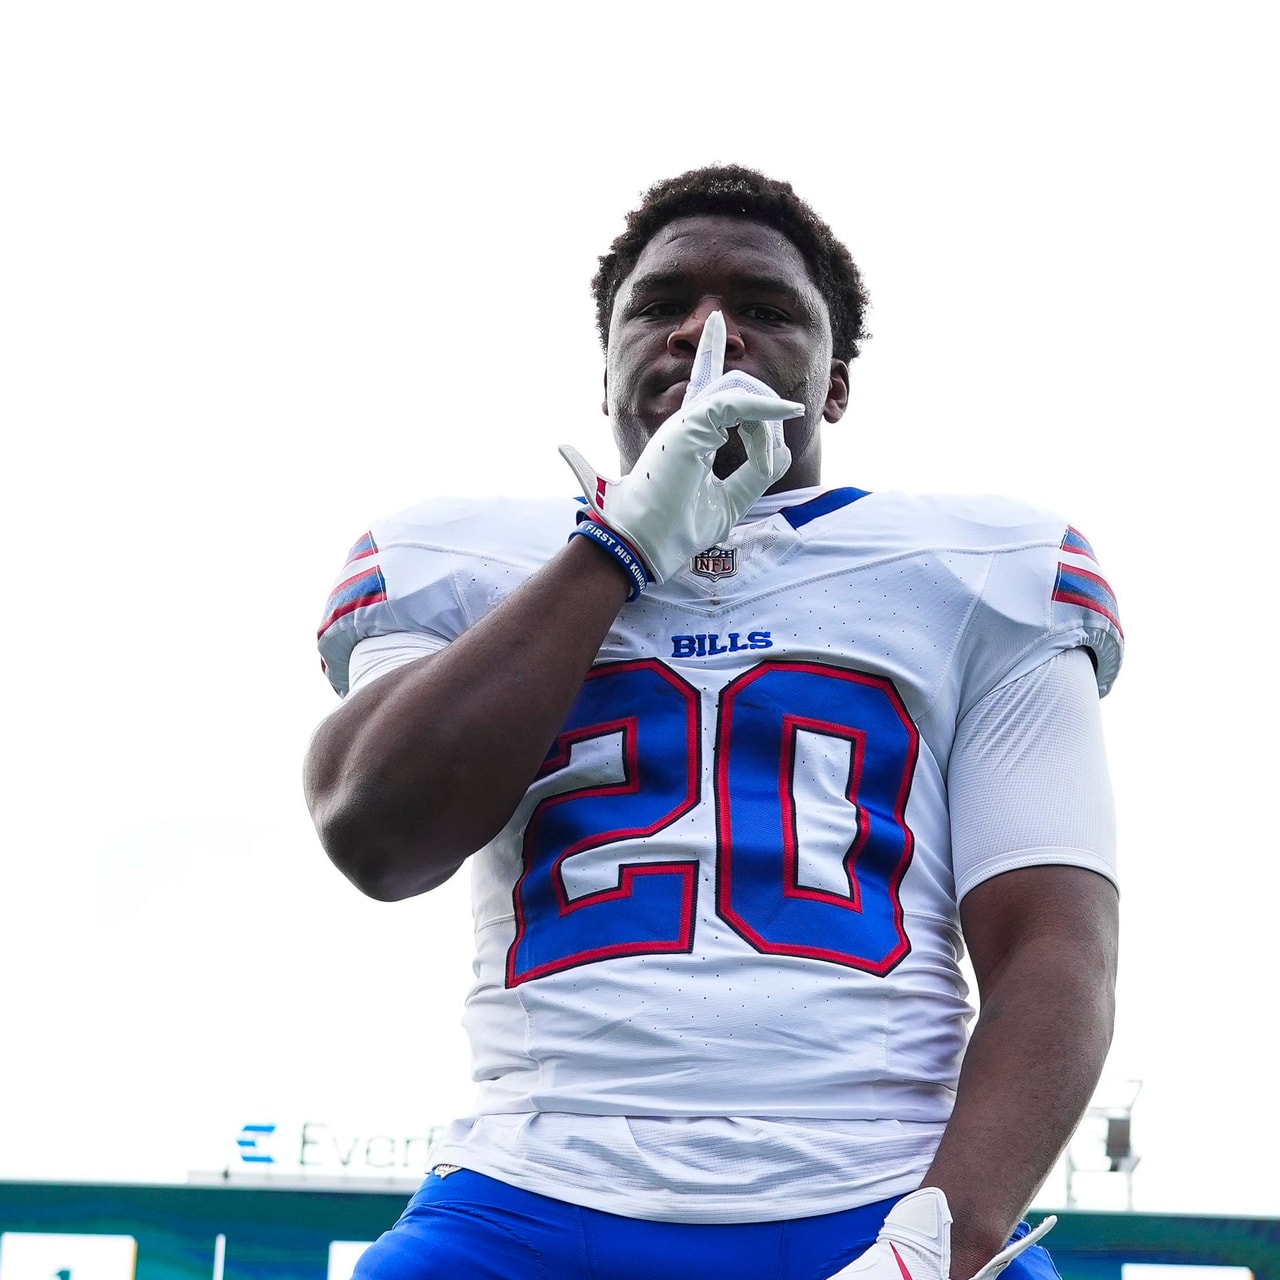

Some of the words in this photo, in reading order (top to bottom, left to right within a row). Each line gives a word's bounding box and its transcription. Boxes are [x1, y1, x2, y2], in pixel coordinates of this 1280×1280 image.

[585, 524, 615, 546] FIRST
[614, 545, 632, 564] HIS
[698, 557, 731, 575] NFL
[671, 631, 774, 658] BILLS
[505, 658, 920, 988] 20
